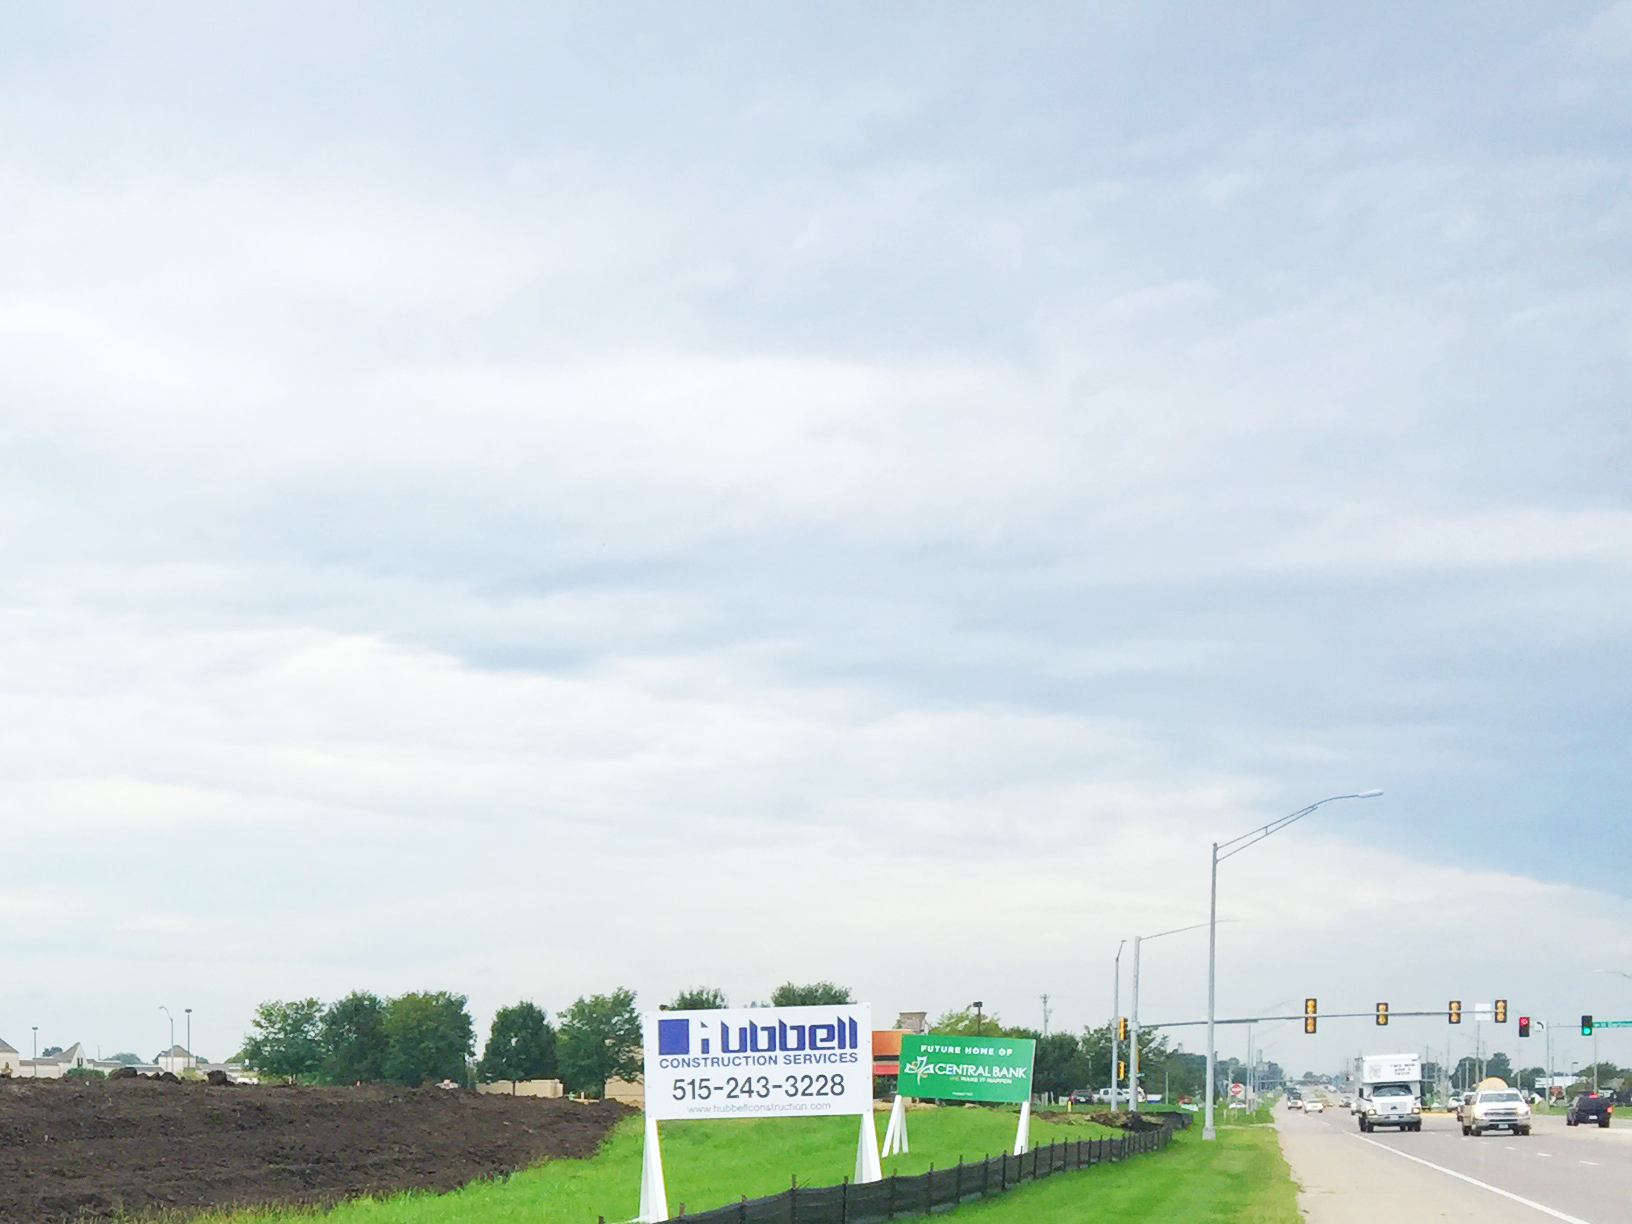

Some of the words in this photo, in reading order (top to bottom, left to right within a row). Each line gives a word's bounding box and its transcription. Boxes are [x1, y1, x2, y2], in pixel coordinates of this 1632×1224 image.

[921, 1045, 961, 1054] FUTURE
[965, 1047, 994, 1056] HOME
[998, 1048, 1013, 1056] OF
[659, 1055, 778, 1069] CONSTRUCTION
[783, 1052, 858, 1065] SERVICES
[935, 1063, 992, 1077] CENTRAL
[992, 1066, 1027, 1079] BANK
[672, 1073, 845, 1101] 515-243-3228
[687, 1101, 831, 1114] www.hubbellconstructioncom
